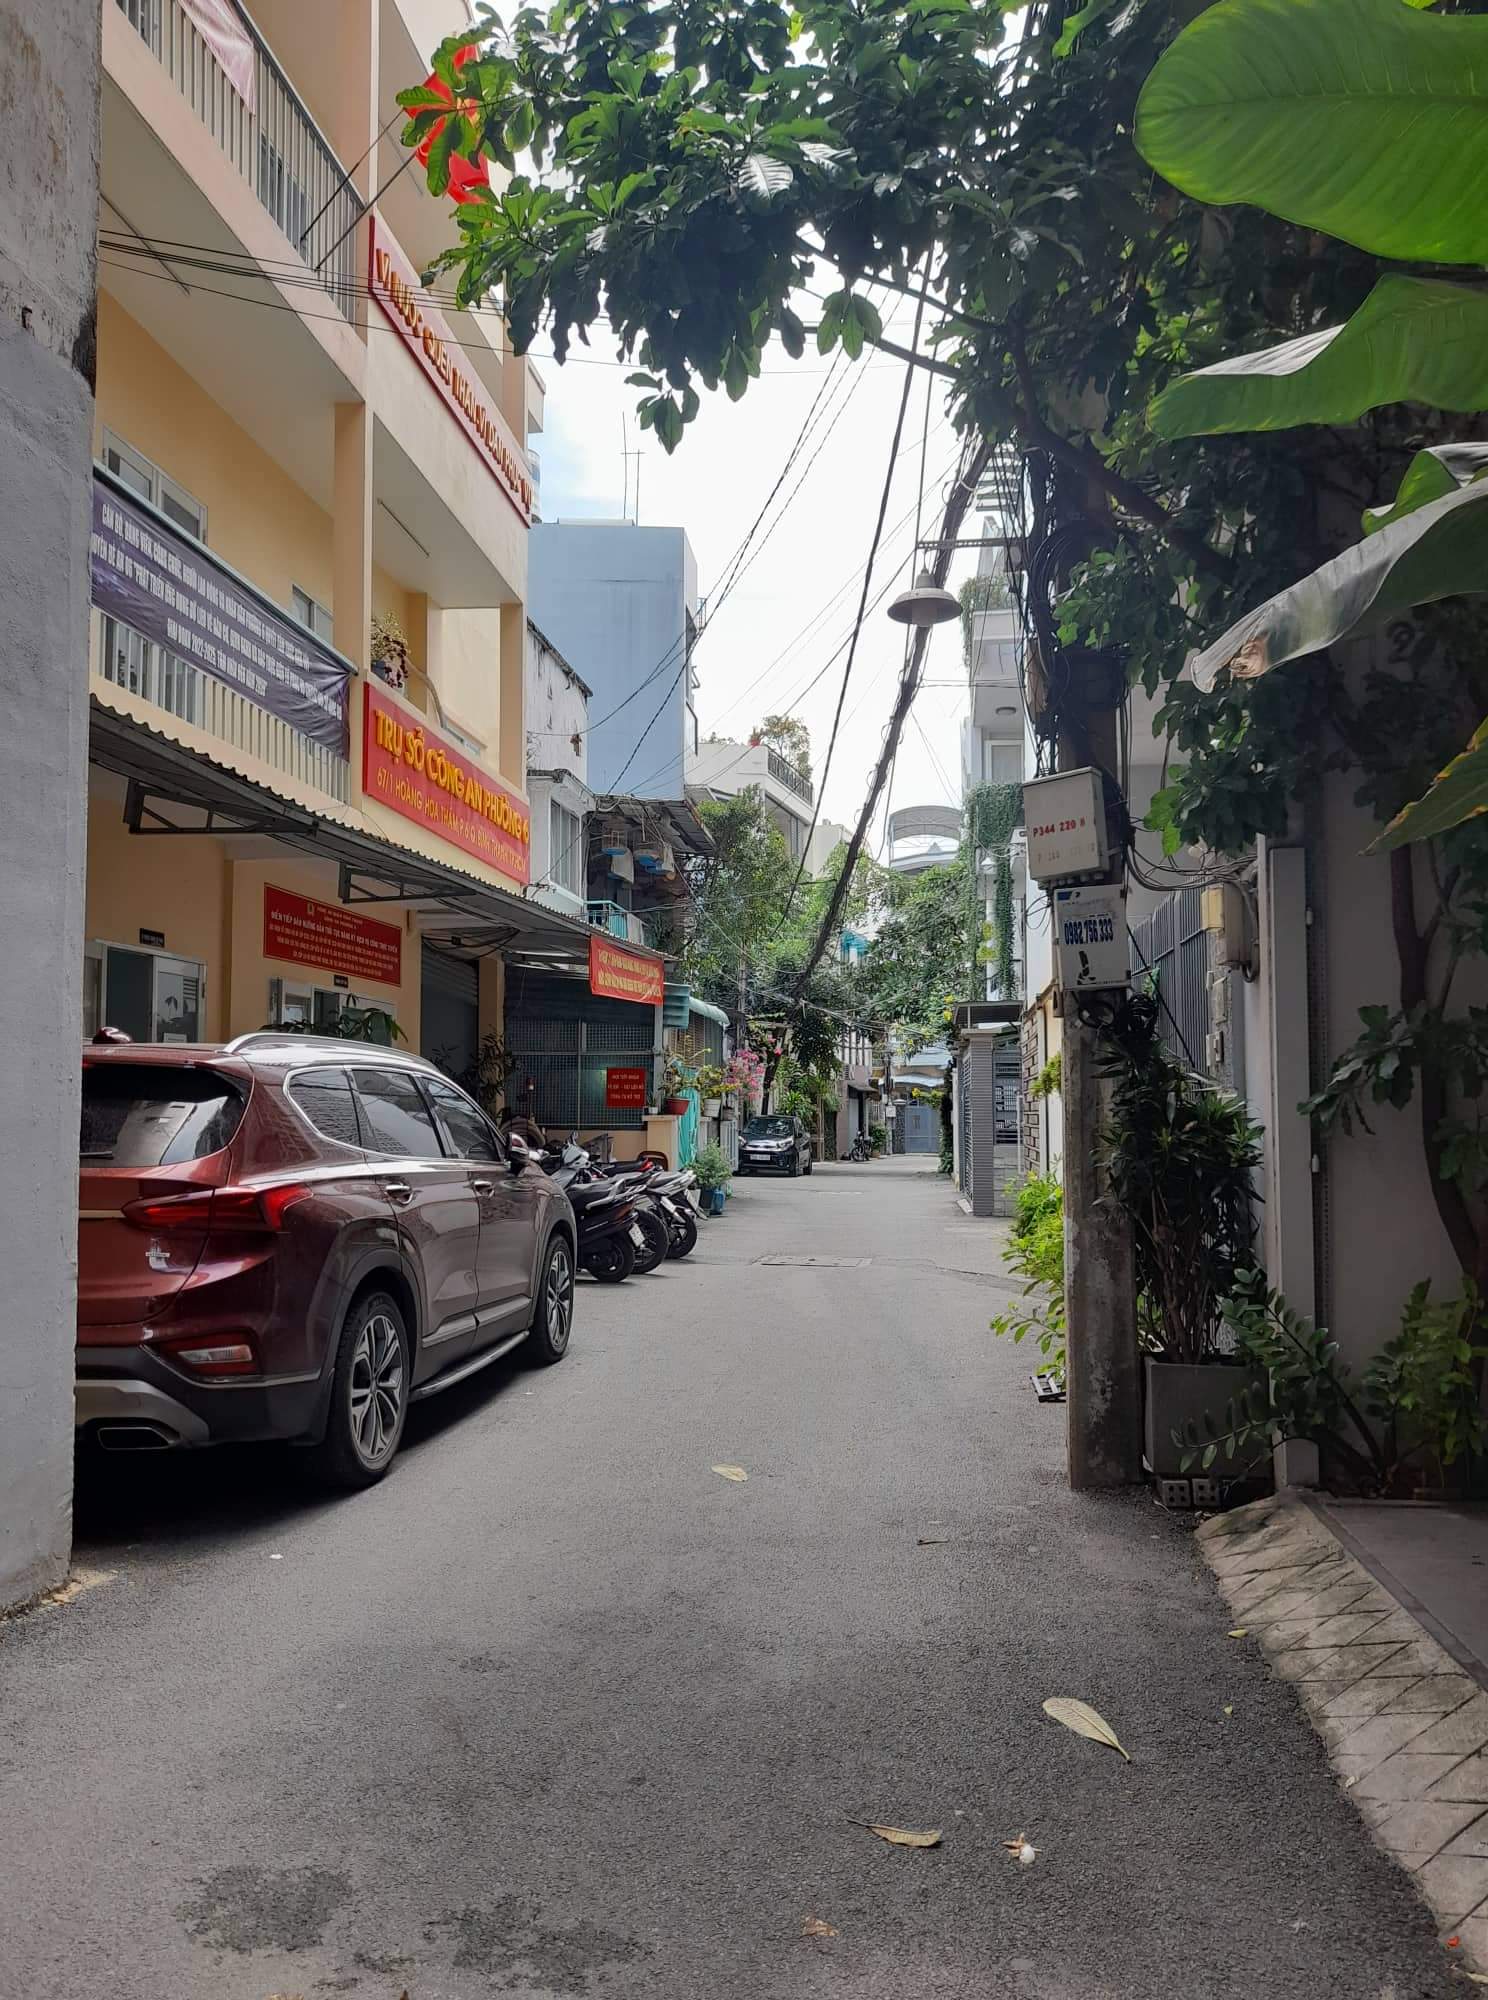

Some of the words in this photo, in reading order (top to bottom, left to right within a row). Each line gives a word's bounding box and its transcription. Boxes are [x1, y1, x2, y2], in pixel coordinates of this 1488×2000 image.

[374, 710, 402, 765] TRỤ
[404, 726, 425, 771] SỞ
[425, 748, 465, 799] CÔNG
[464, 777, 483, 814] AN
[482, 791, 522, 840] PHƯỜNG
[521, 818, 529, 845] 6
[395, 777, 423, 809] HOÀNG
[1059, 819, 1077, 832] 220
